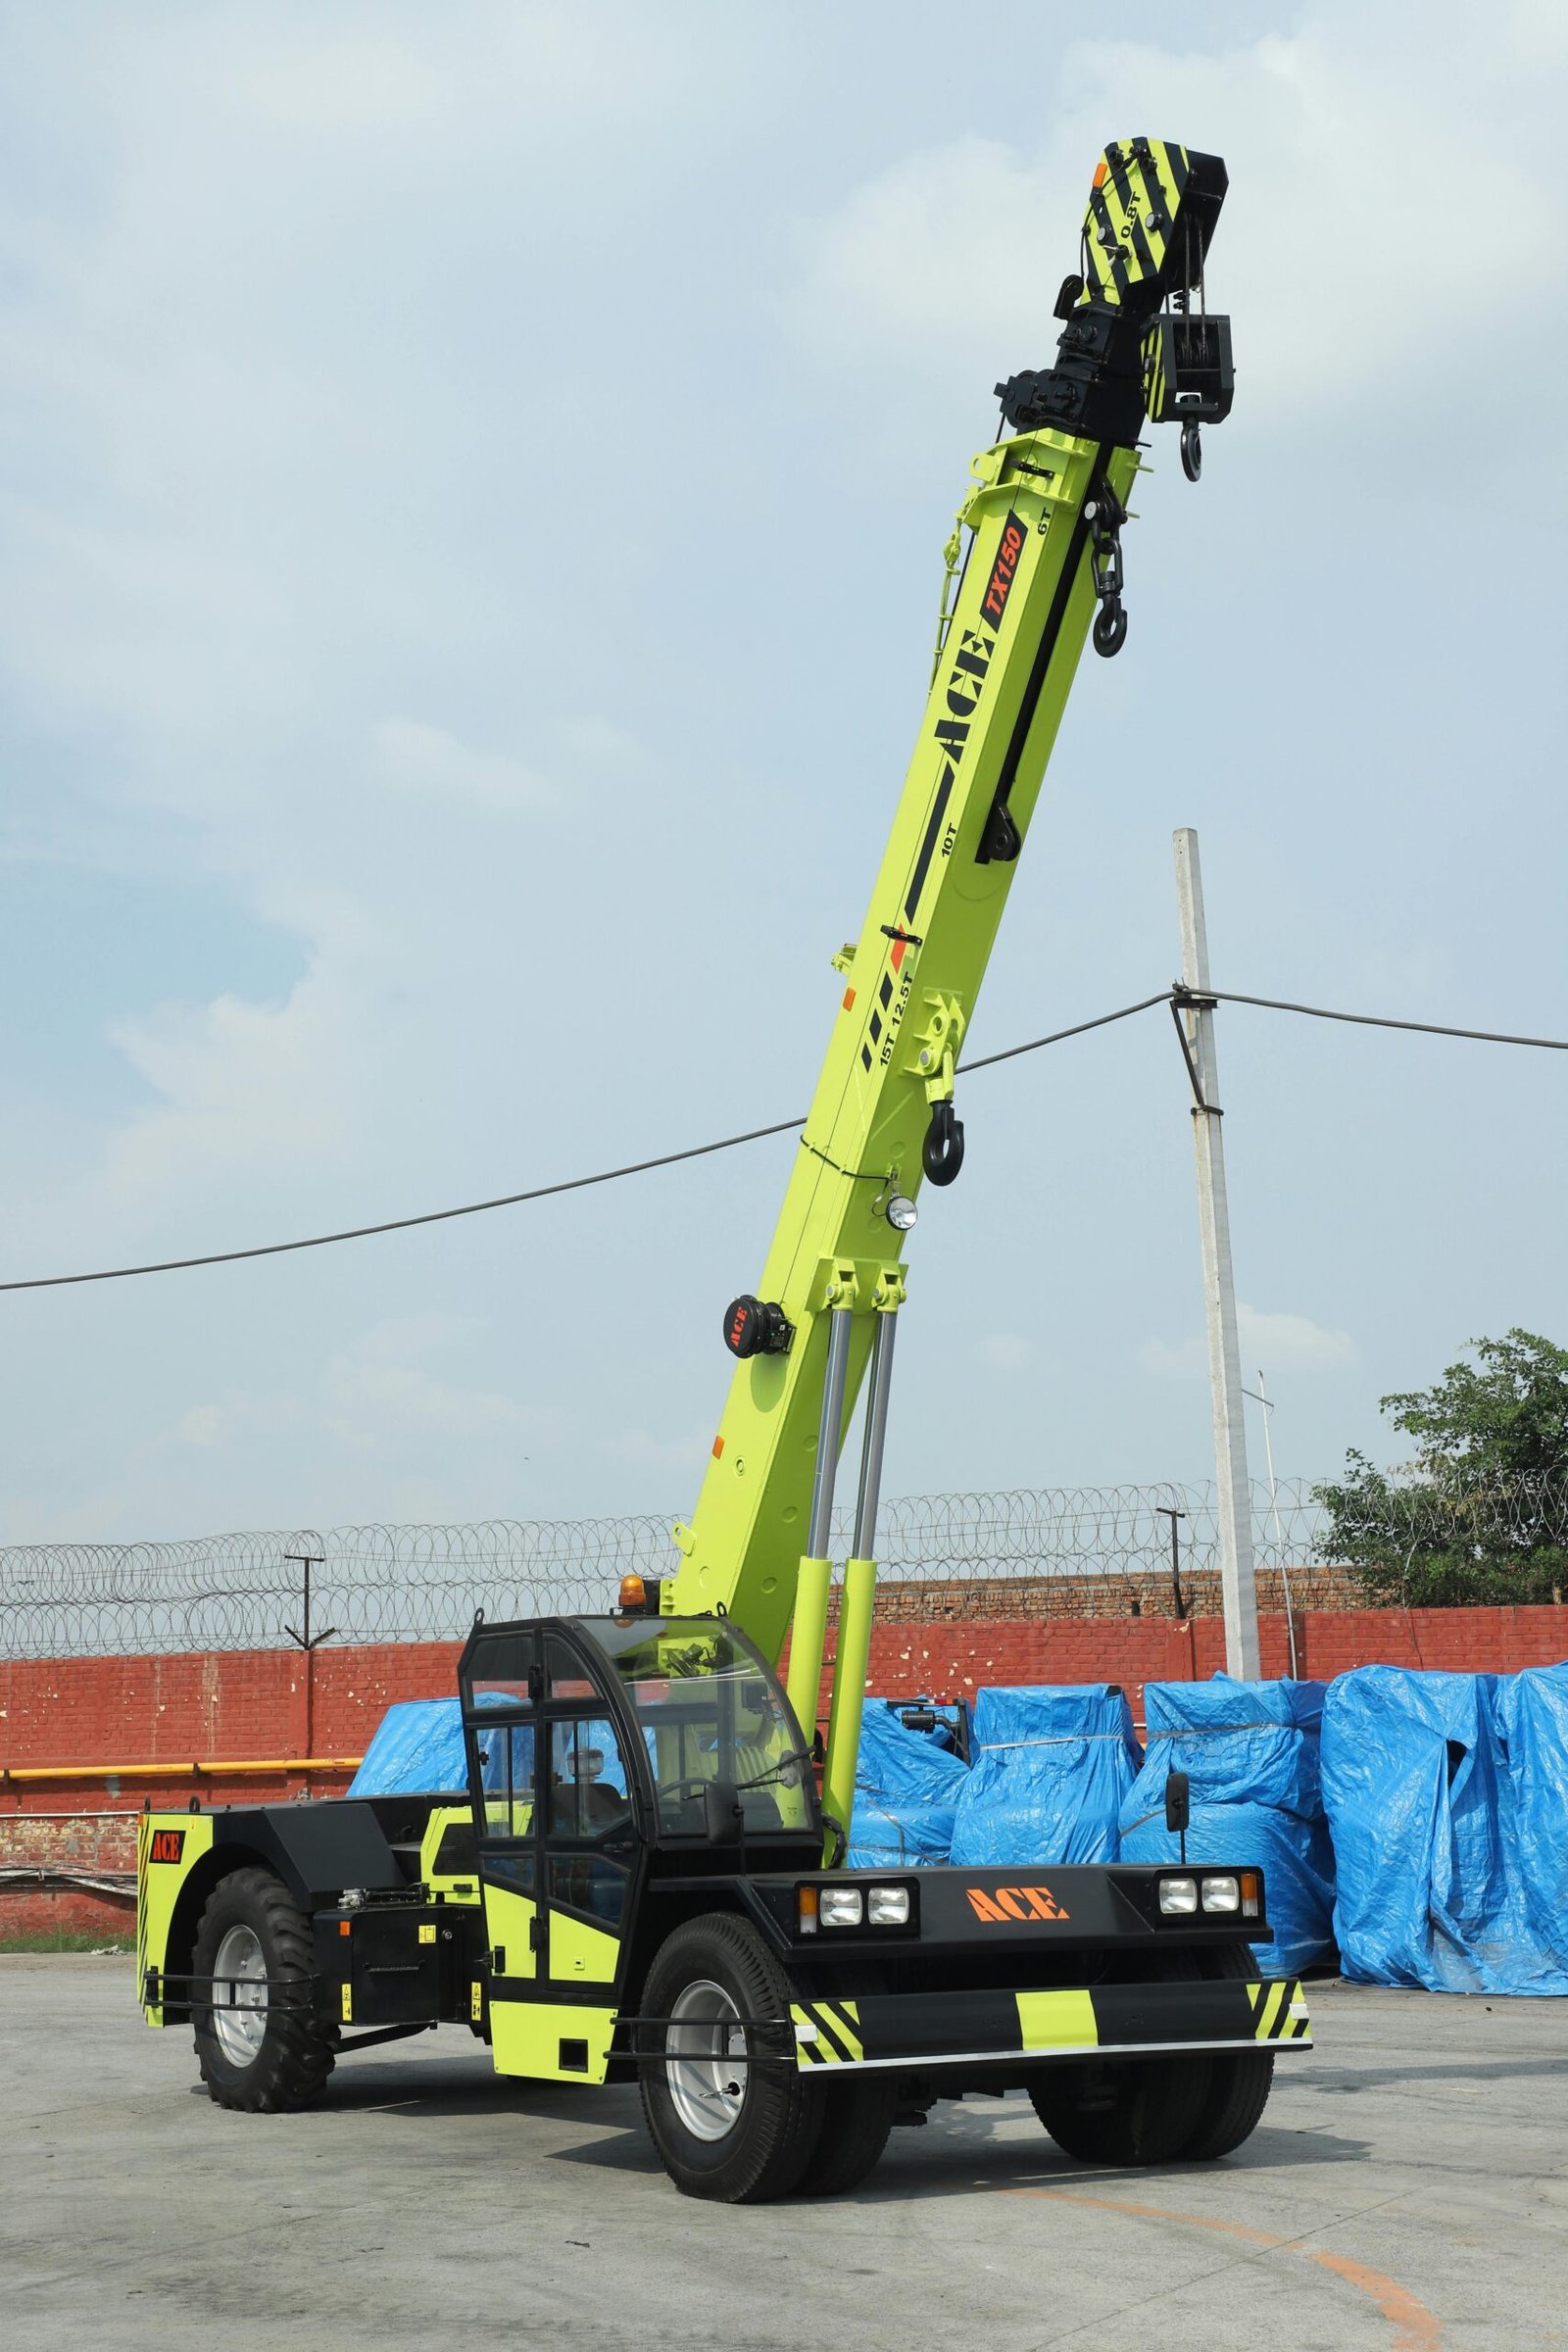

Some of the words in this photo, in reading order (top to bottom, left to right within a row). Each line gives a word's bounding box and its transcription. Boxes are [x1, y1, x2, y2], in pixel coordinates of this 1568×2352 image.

[1121, 191, 1141, 238] 0.8T
[1038, 507, 1051, 535] 6T
[934, 628, 996, 765] ACE
[986, 525, 1022, 615] TX150
[942, 822, 956, 858] 10T
[880, 1032, 895, 1066] 15T
[892, 971, 913, 1026] 12.5T
[730, 1305, 748, 1348] ACE
[152, 1833, 179, 1861] ACE
[965, 1886, 1070, 1922] ACE
